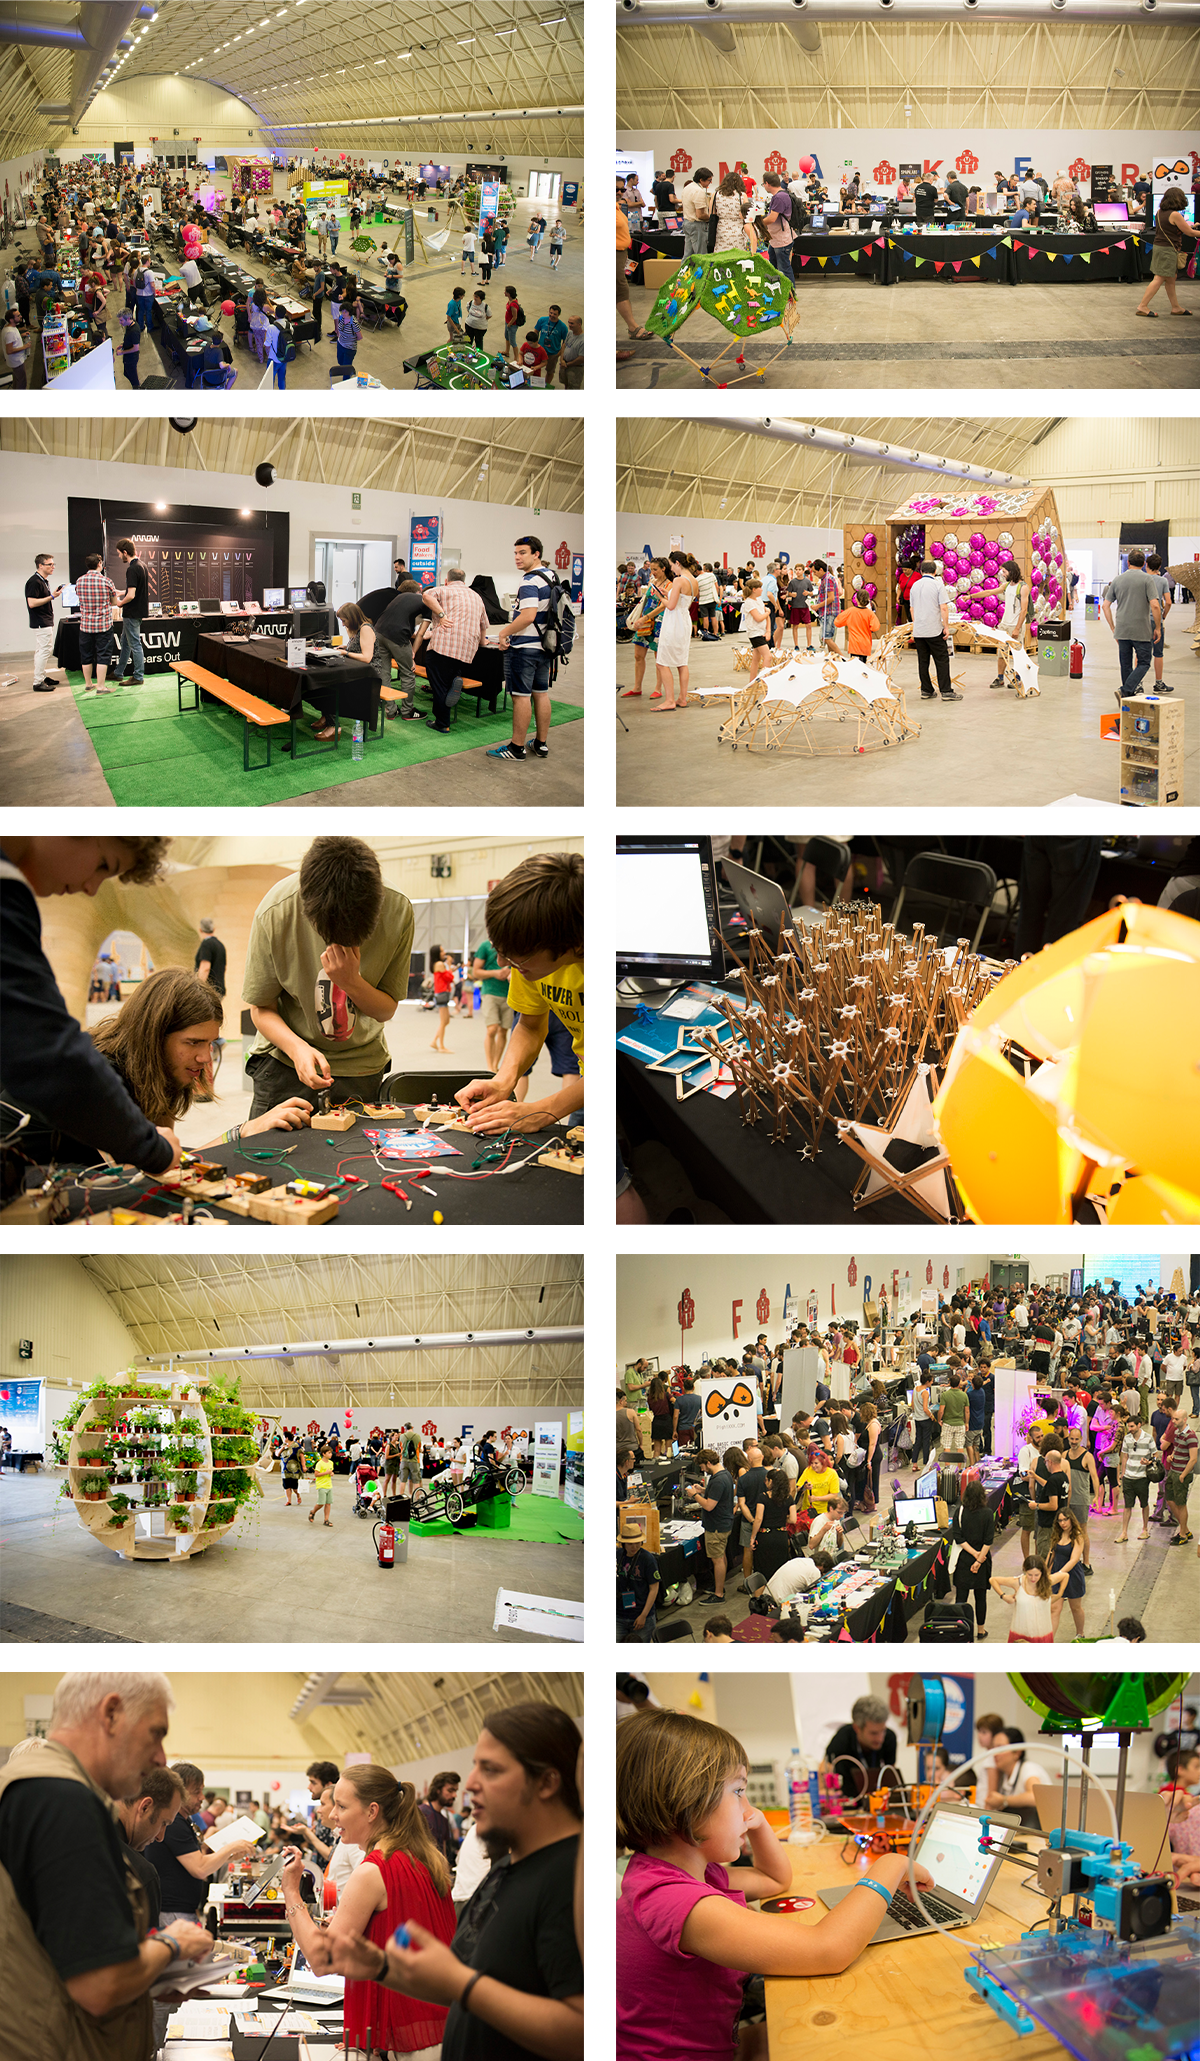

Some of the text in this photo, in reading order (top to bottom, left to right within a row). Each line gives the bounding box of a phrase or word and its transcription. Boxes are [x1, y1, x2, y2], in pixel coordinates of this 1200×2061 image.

[1015, 157, 1031, 182] E
[1122, 164, 1139, 185] R
[110, 656, 132, 665] Fie
[164, 652, 180, 662] Out
[541, 982, 573, 1006] NEVER
[864, 1275, 872, 1302] R
[732, 1299, 743, 1339] F
[328, 1422, 340, 1437] A
